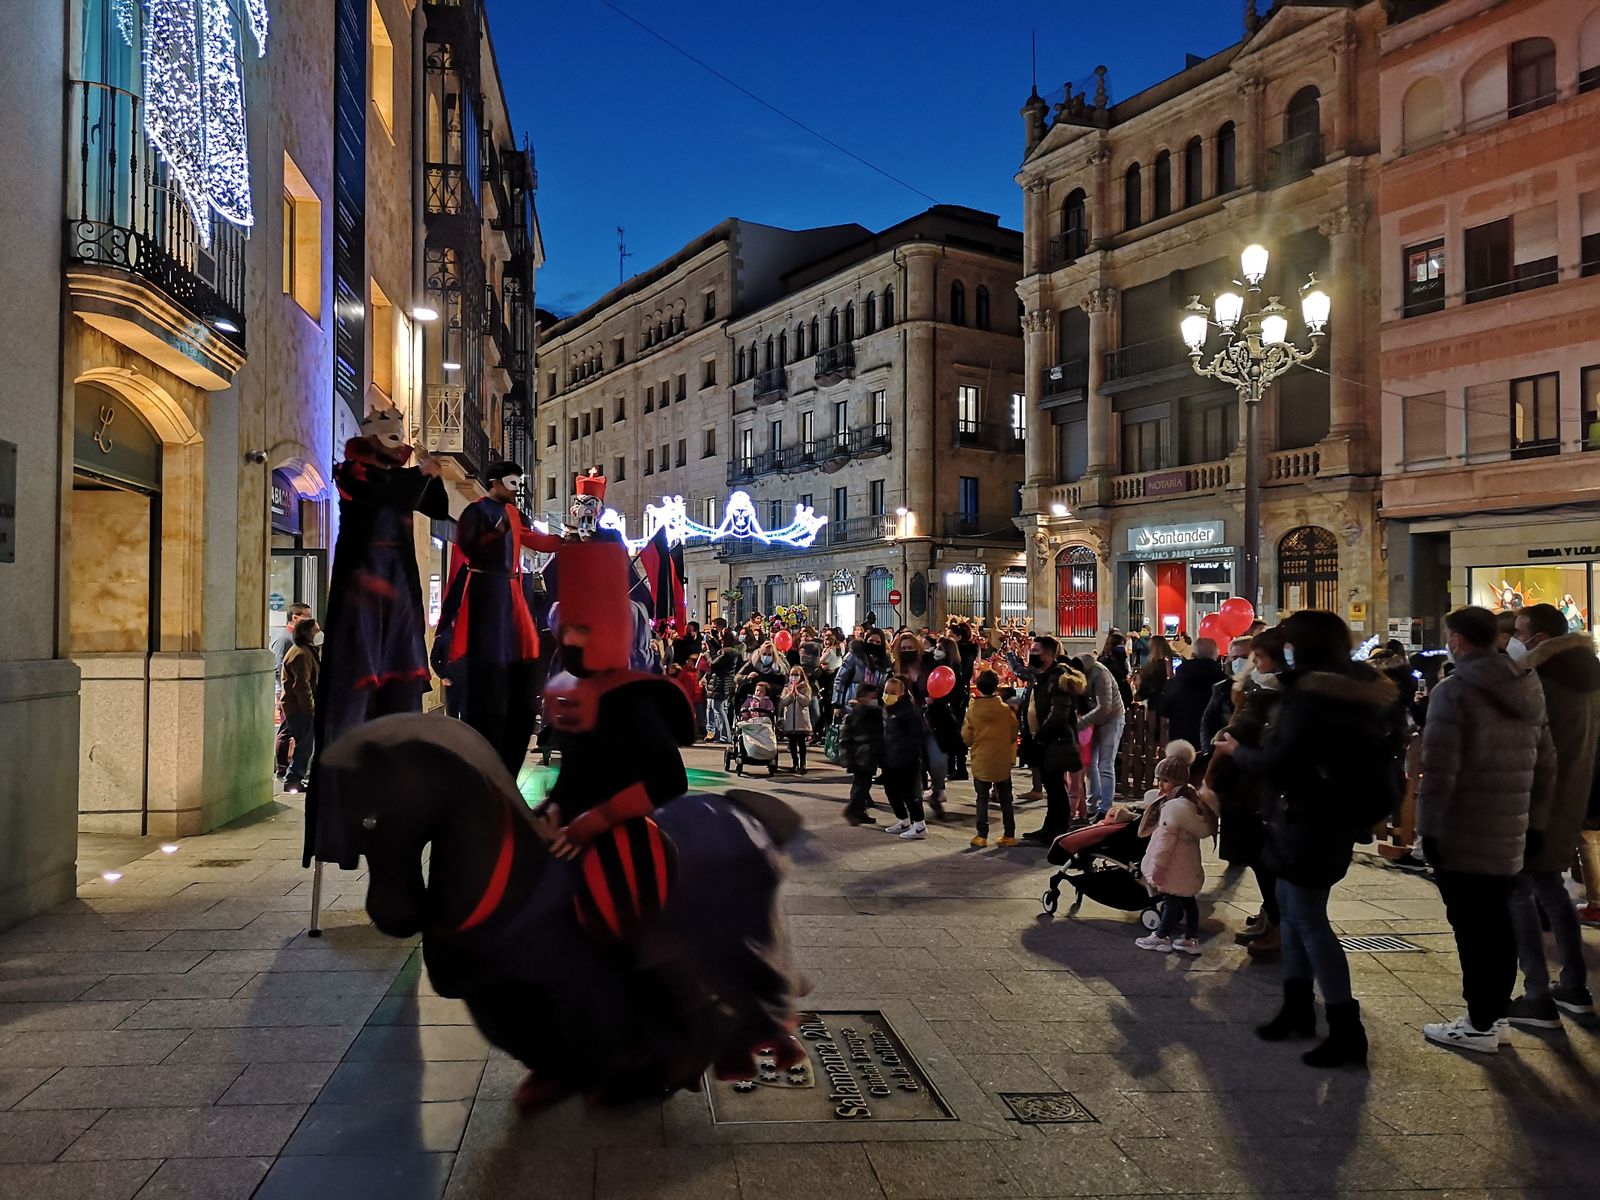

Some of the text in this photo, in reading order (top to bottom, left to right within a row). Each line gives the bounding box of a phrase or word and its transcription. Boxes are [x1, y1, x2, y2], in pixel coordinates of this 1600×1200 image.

[1148, 477, 1183, 490] NOTARÍA
[1152, 528, 1211, 545] Santander
[1564, 547, 1573, 556] Y
[841, 1026, 891, 1095] Ciudad Europea
[869, 1028, 918, 1090] de la Cultura
[815, 1042, 872, 1118] Salamanca
